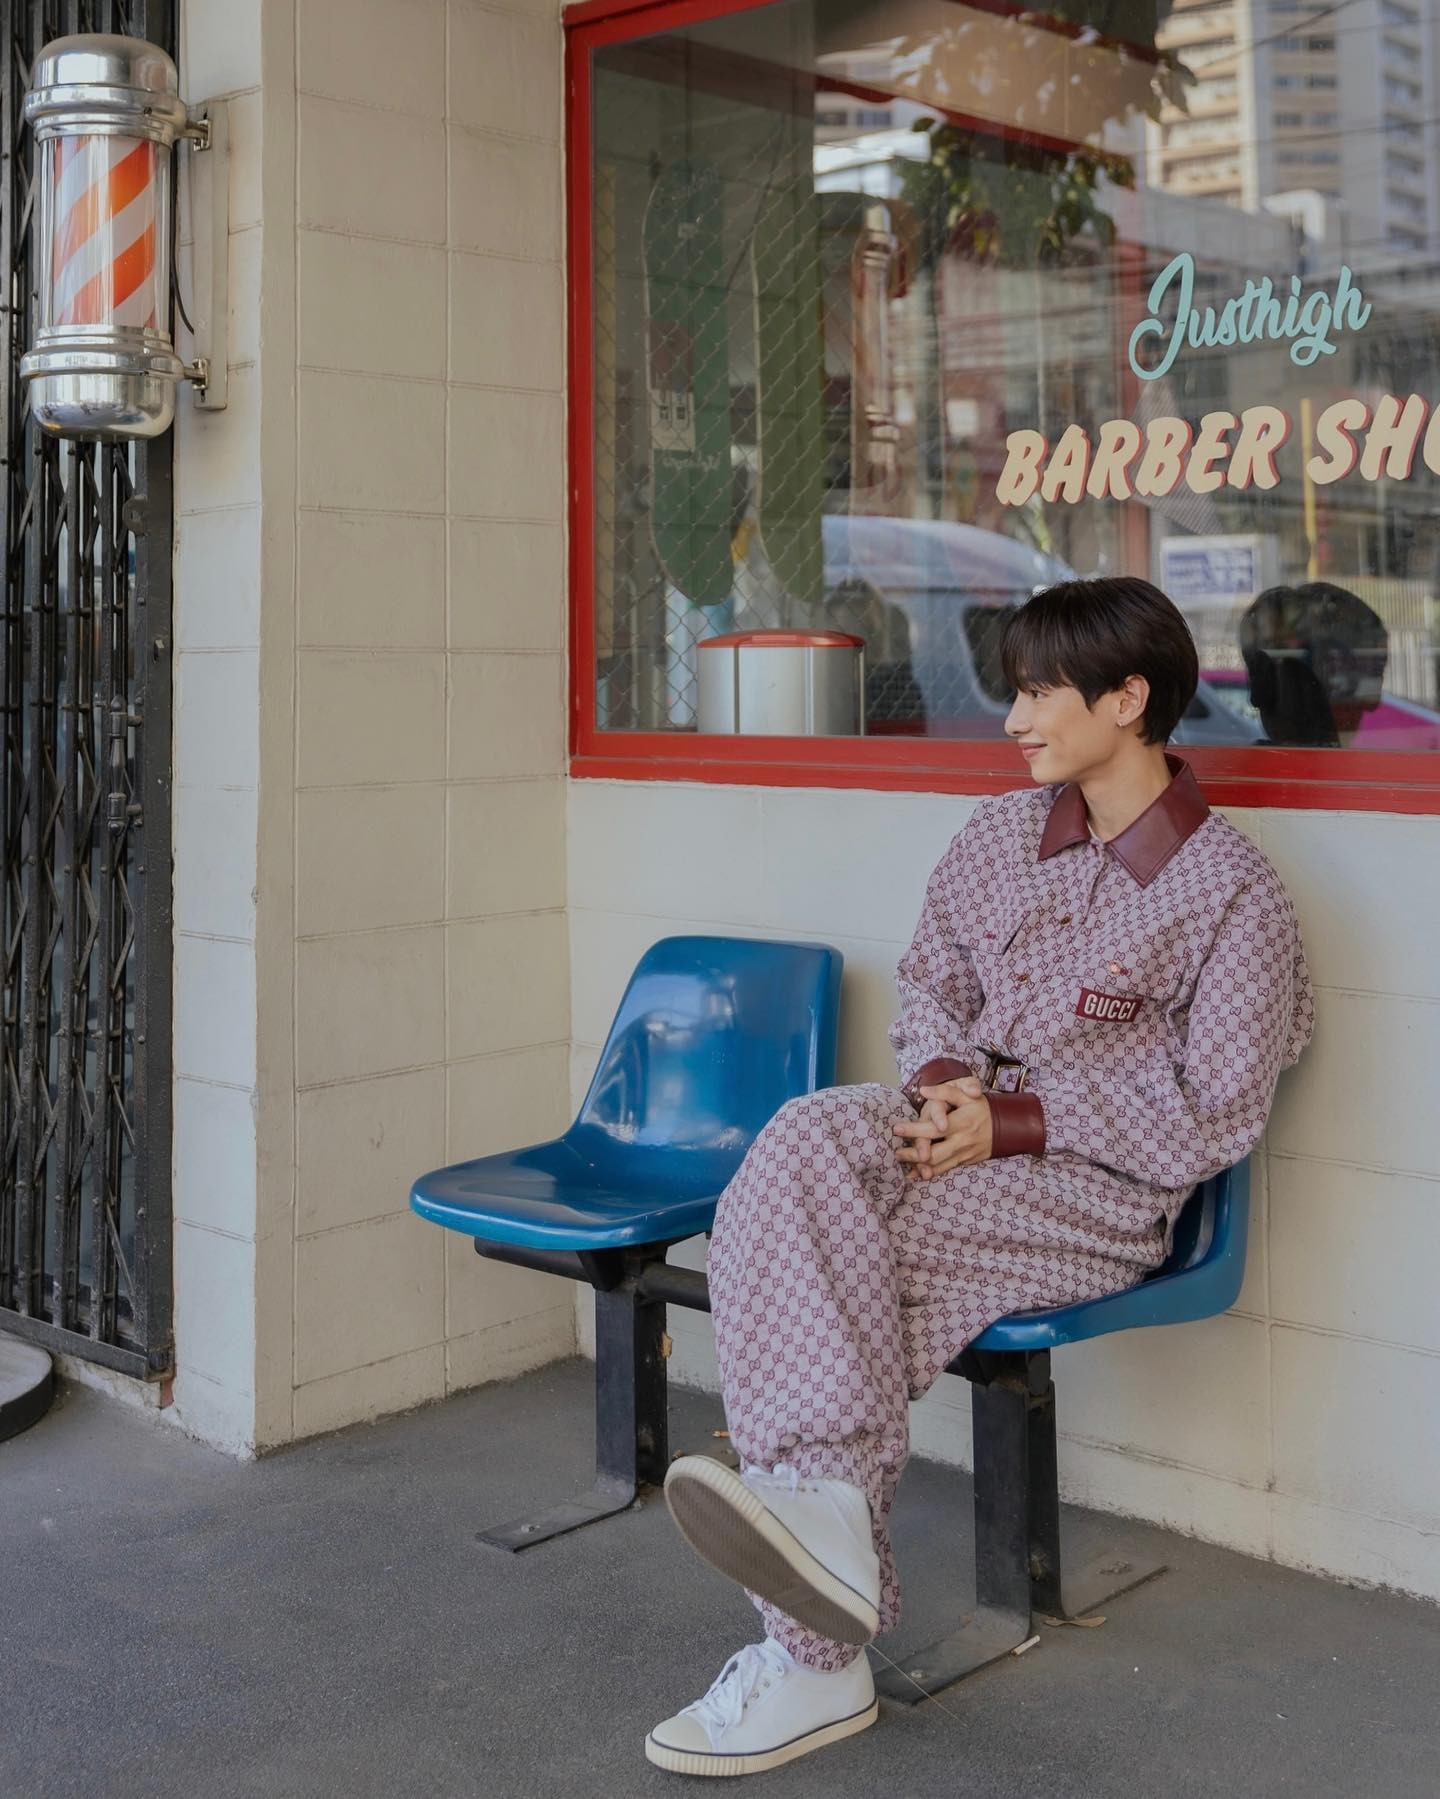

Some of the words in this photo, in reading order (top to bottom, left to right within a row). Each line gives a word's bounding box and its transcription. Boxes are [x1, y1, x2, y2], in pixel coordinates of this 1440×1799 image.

[1128, 252, 1372, 380] Justhigh
[996, 405, 1292, 508] BARBER
[1083, 993, 1137, 1020] GUCCI
